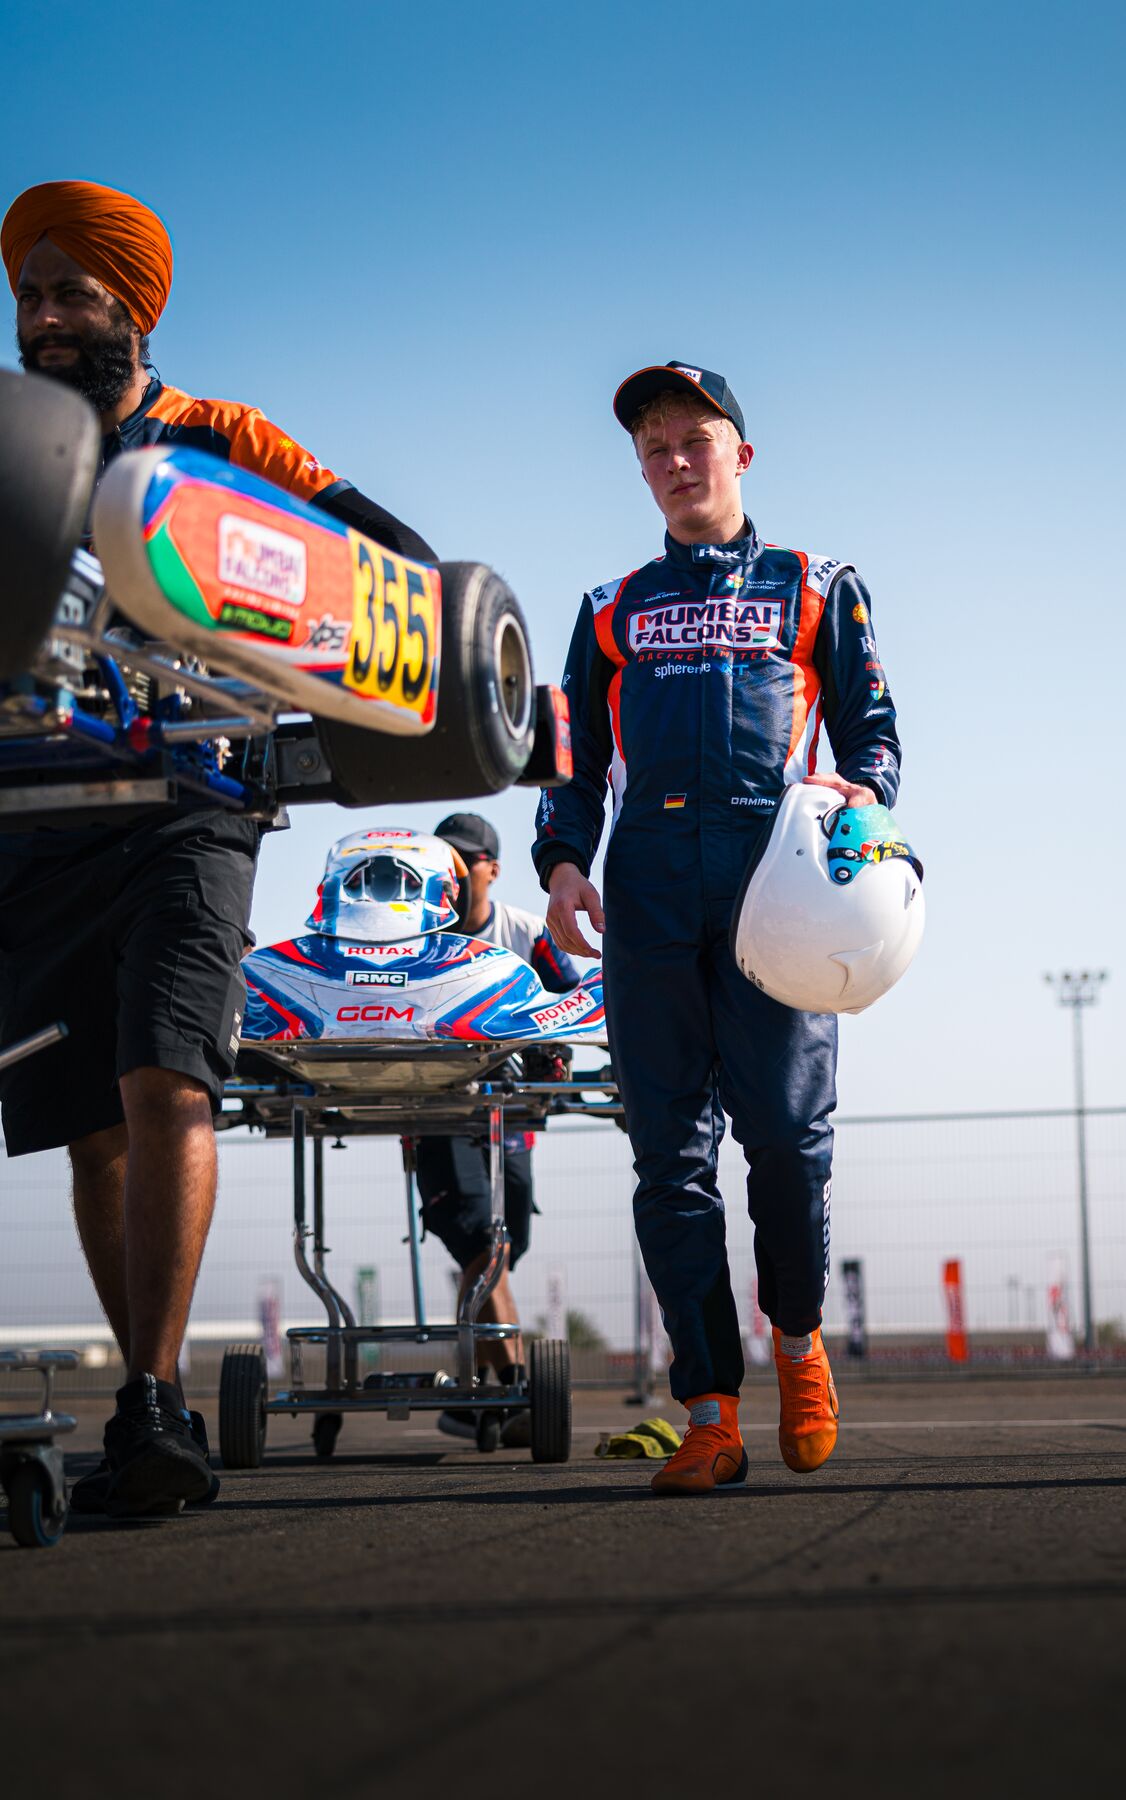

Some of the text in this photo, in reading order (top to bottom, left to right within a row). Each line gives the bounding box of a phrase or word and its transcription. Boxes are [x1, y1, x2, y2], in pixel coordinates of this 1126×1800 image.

[352, 541, 431, 703] 355
[638, 602, 772, 631] MUMBAI
[634, 623, 752, 646] FALCONS
[638, 649, 769, 663] RACING LIMITED
[347, 946, 414, 956] ROTAX
[355, 973, 404, 985] RMC
[336, 1005, 415, 1023] GGM
[534, 992, 587, 1024] ROTAX
